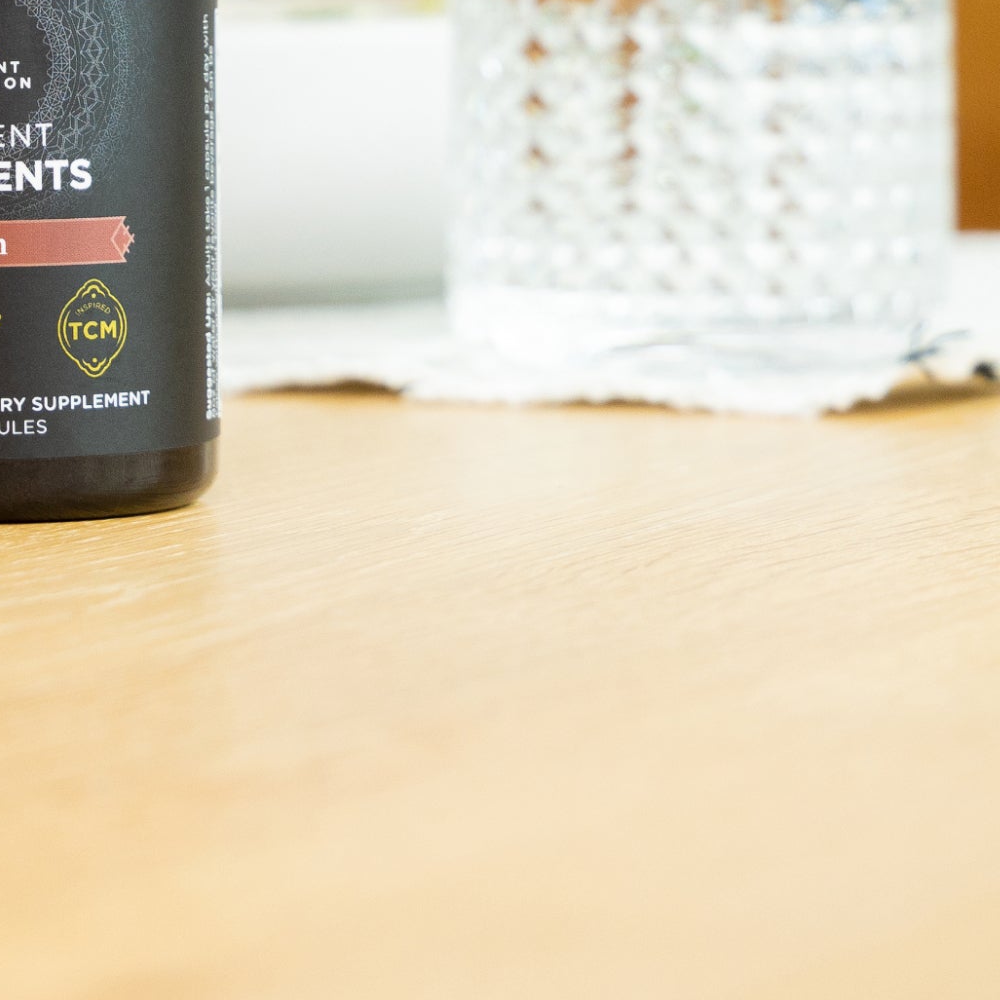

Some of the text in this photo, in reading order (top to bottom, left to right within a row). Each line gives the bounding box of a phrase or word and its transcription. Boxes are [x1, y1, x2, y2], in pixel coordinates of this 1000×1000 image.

[202, 54, 210, 83] day
[75, 302, 111, 317] INSPIRED
[68, 320, 117, 340] TCM
[32, 390, 150, 411] SUPPLEMENT
